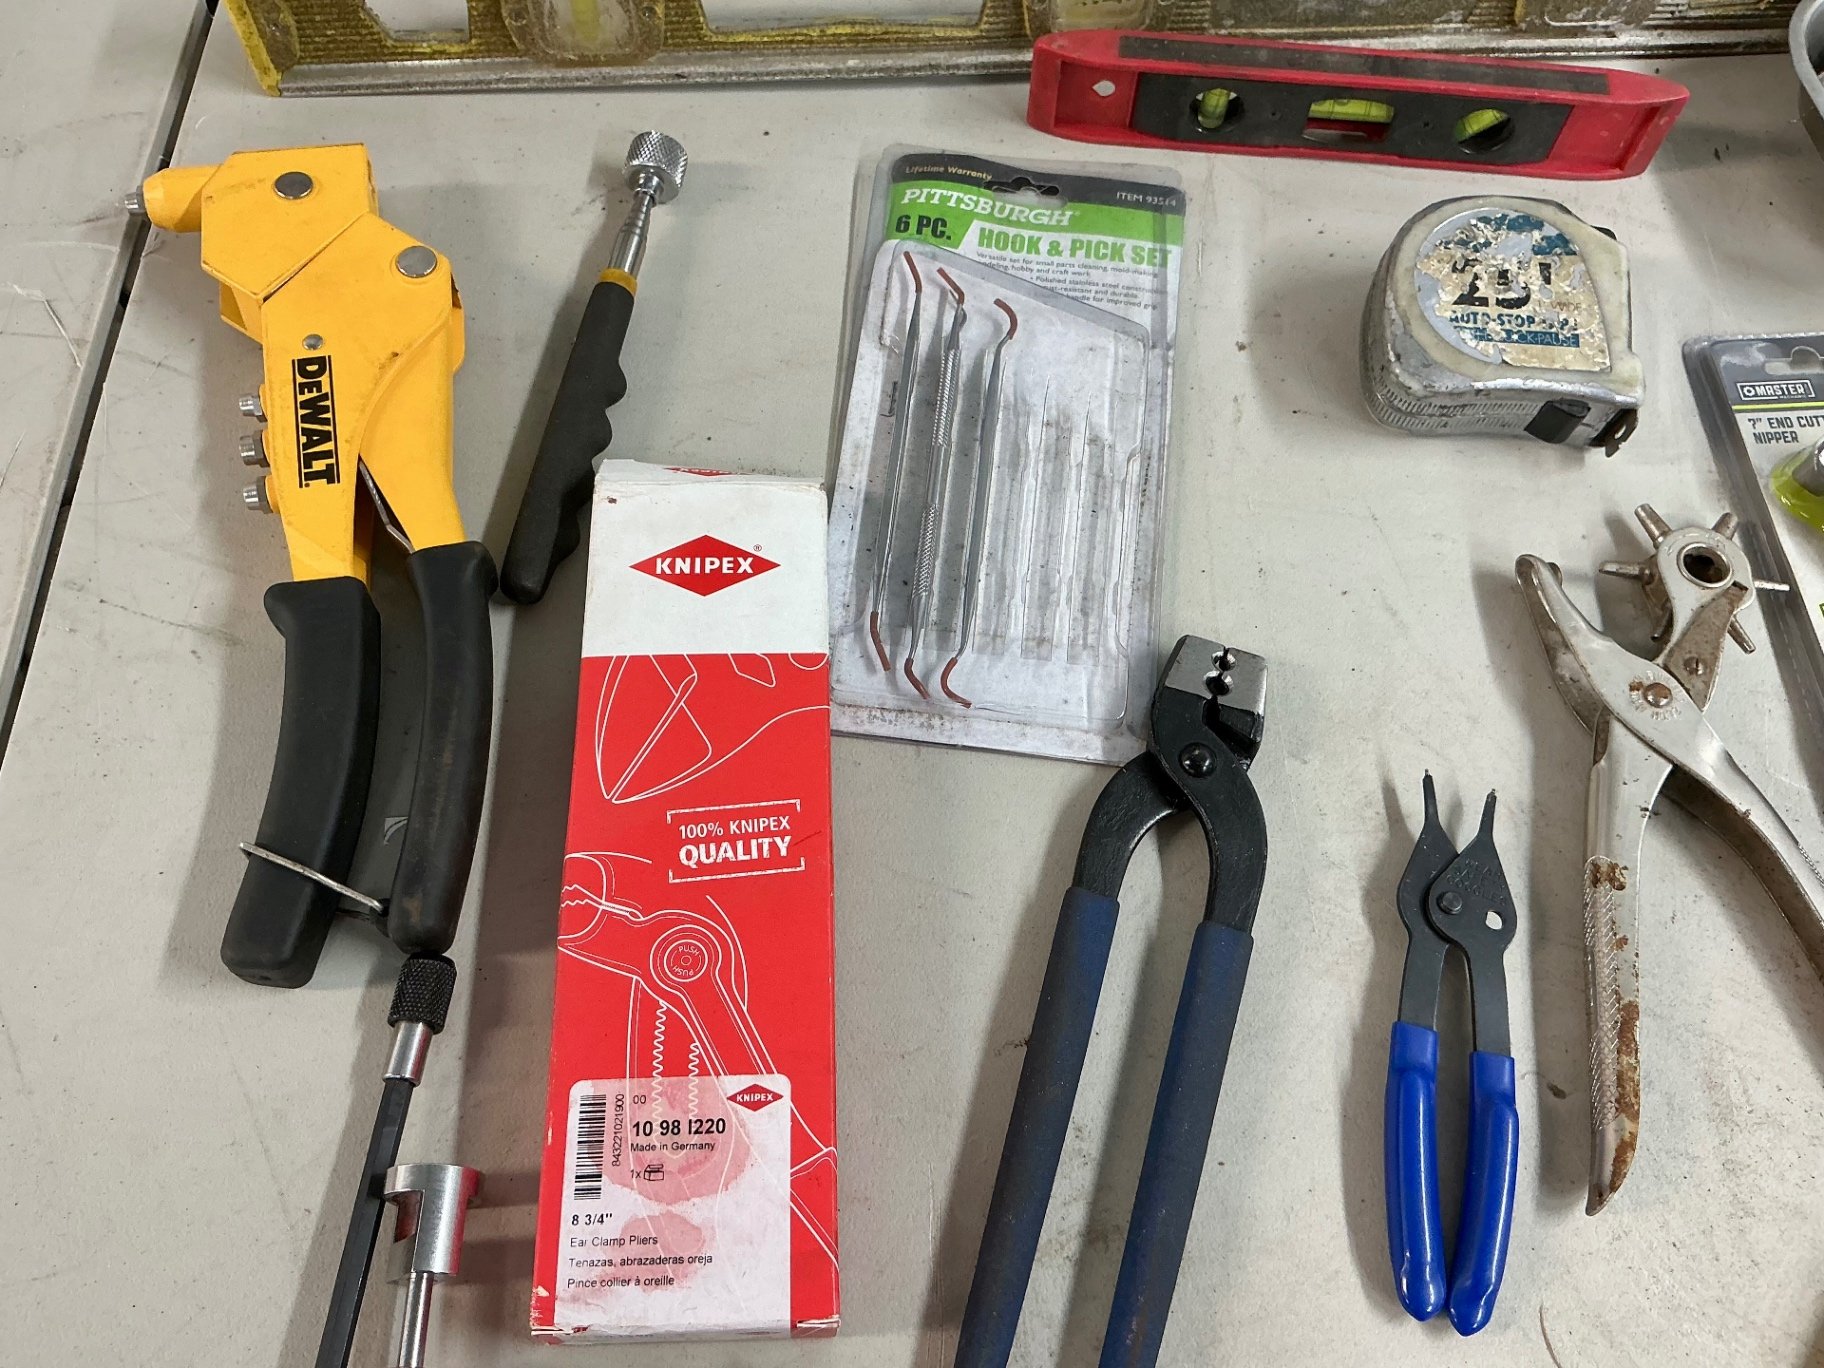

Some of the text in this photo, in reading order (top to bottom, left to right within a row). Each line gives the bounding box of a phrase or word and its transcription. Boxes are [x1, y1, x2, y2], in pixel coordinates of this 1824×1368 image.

[905, 166, 993, 181] Lifetime Warranty
[1116, 191, 1143, 203] ITEM
[901, 188, 1073, 226] PITTSBURGH
[895, 214, 952, 241] 6 PC.
[978, 227, 1172, 268] HOOK & PICK SET
[977, 251, 1007, 262] Versatile
[1022, 257, 1034, 265] for
[1011, 265, 1034, 274] hobby
[1036, 267, 1051, 275] and
[1052, 268, 1070, 276] craft
[1035, 276, 1067, 285] Polished
[1101, 281, 1120, 289] steel
[1754, 384, 1805, 396] MASTER
[297, 355, 336, 487] DEWALT
[1766, 416, 1794, 429] END
[1753, 430, 1799, 444] NIPPER
[655, 557, 754, 574] KNIPEX
[679, 815, 791, 839] 100% KNIPEX
[679, 835, 792, 869] QUALITY
[678, 945, 700, 956] PUSH
[672, 965, 694, 977] PUSH
[632, 1094, 647, 1104] 00
[736, 1093, 774, 1102] KNIPEX
[612, 1094, 625, 1167] 843221021900
[632, 1120, 653, 1137] 10
[659, 1119, 681, 1136] 98
[630, 1141, 716, 1152] Made in Germany
[630, 1169, 642, 1179] 1x
[571, 1214, 580, 1226] 8
[570, 1235, 658, 1249] Ear Clamp Pliers
[568, 1254, 713, 1269] Tenazas, abrazaderas oreja
[567, 1275, 675, 1289] Pince collier à oreille
